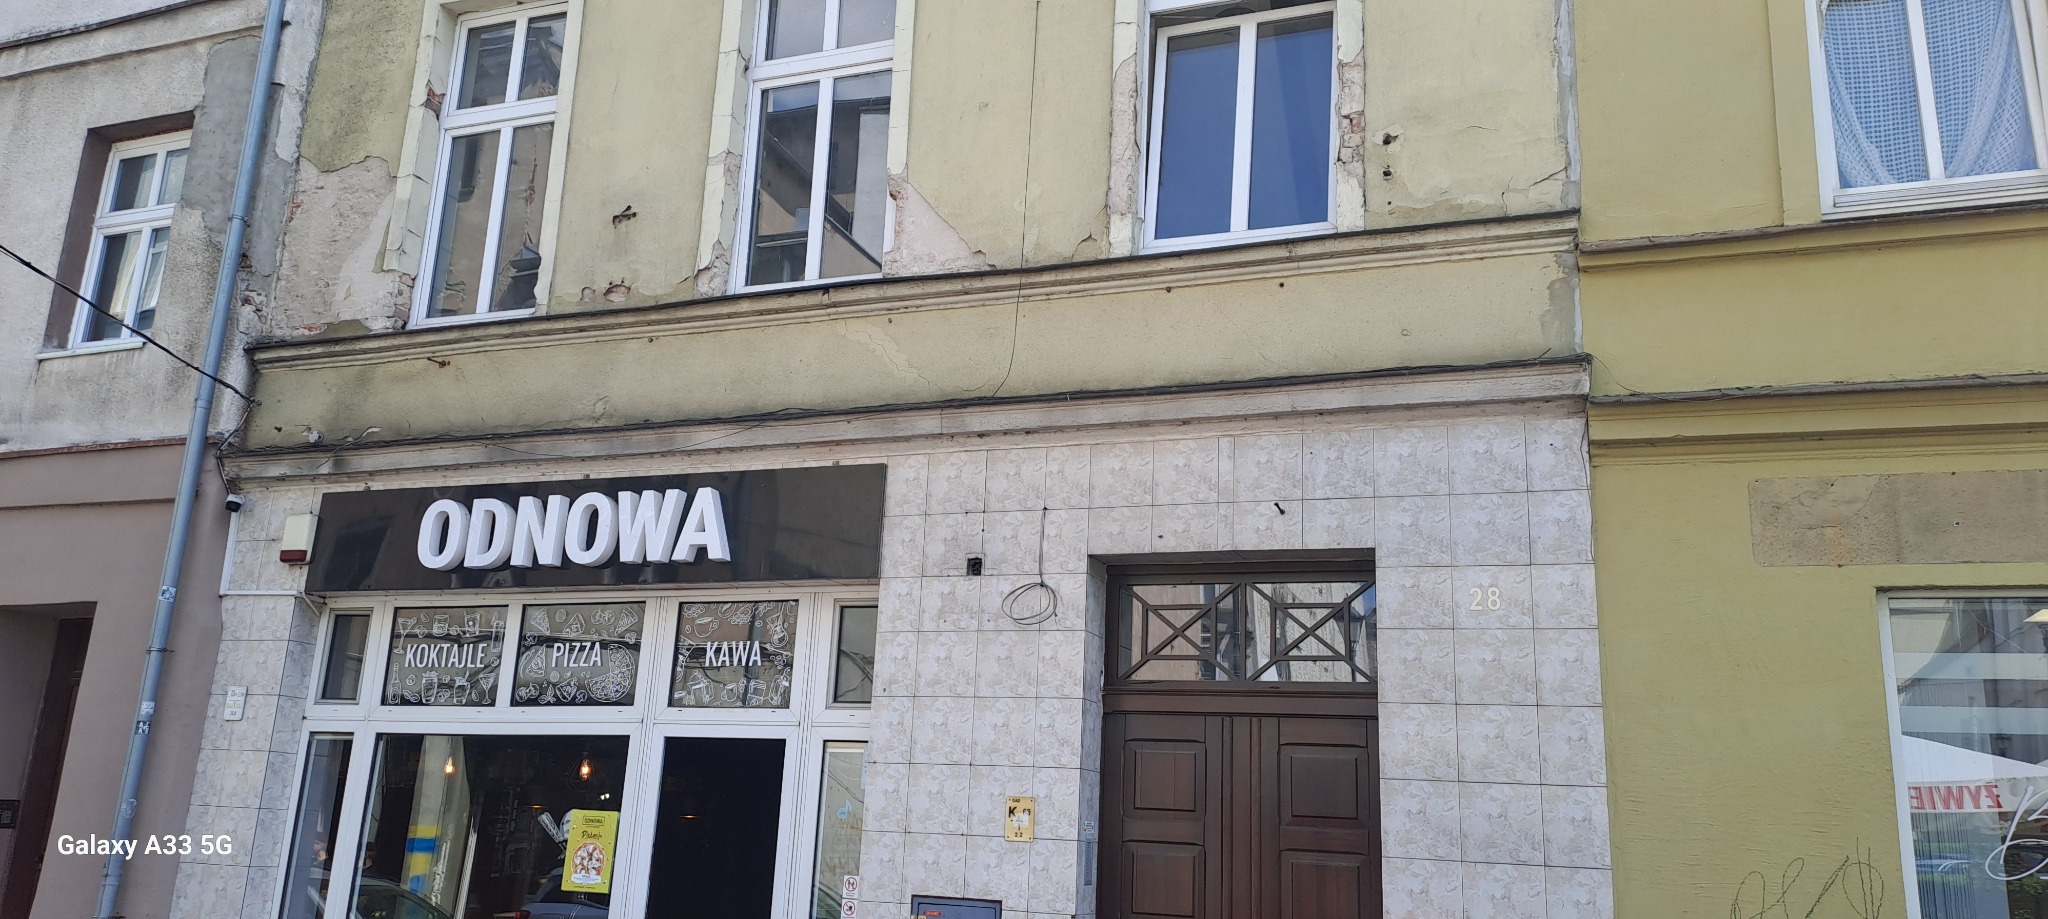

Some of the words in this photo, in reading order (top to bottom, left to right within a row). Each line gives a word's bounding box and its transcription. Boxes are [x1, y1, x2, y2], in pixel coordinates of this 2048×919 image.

[417, 487, 731, 570] ODNOWA
[1469, 587, 1501, 610] 28
[404, 643, 488, 668] KOKTAJLE
[551, 641, 602, 668] PIZZA
[705, 640, 761, 667] KAWA
[1008, 806, 1017, 818] K
